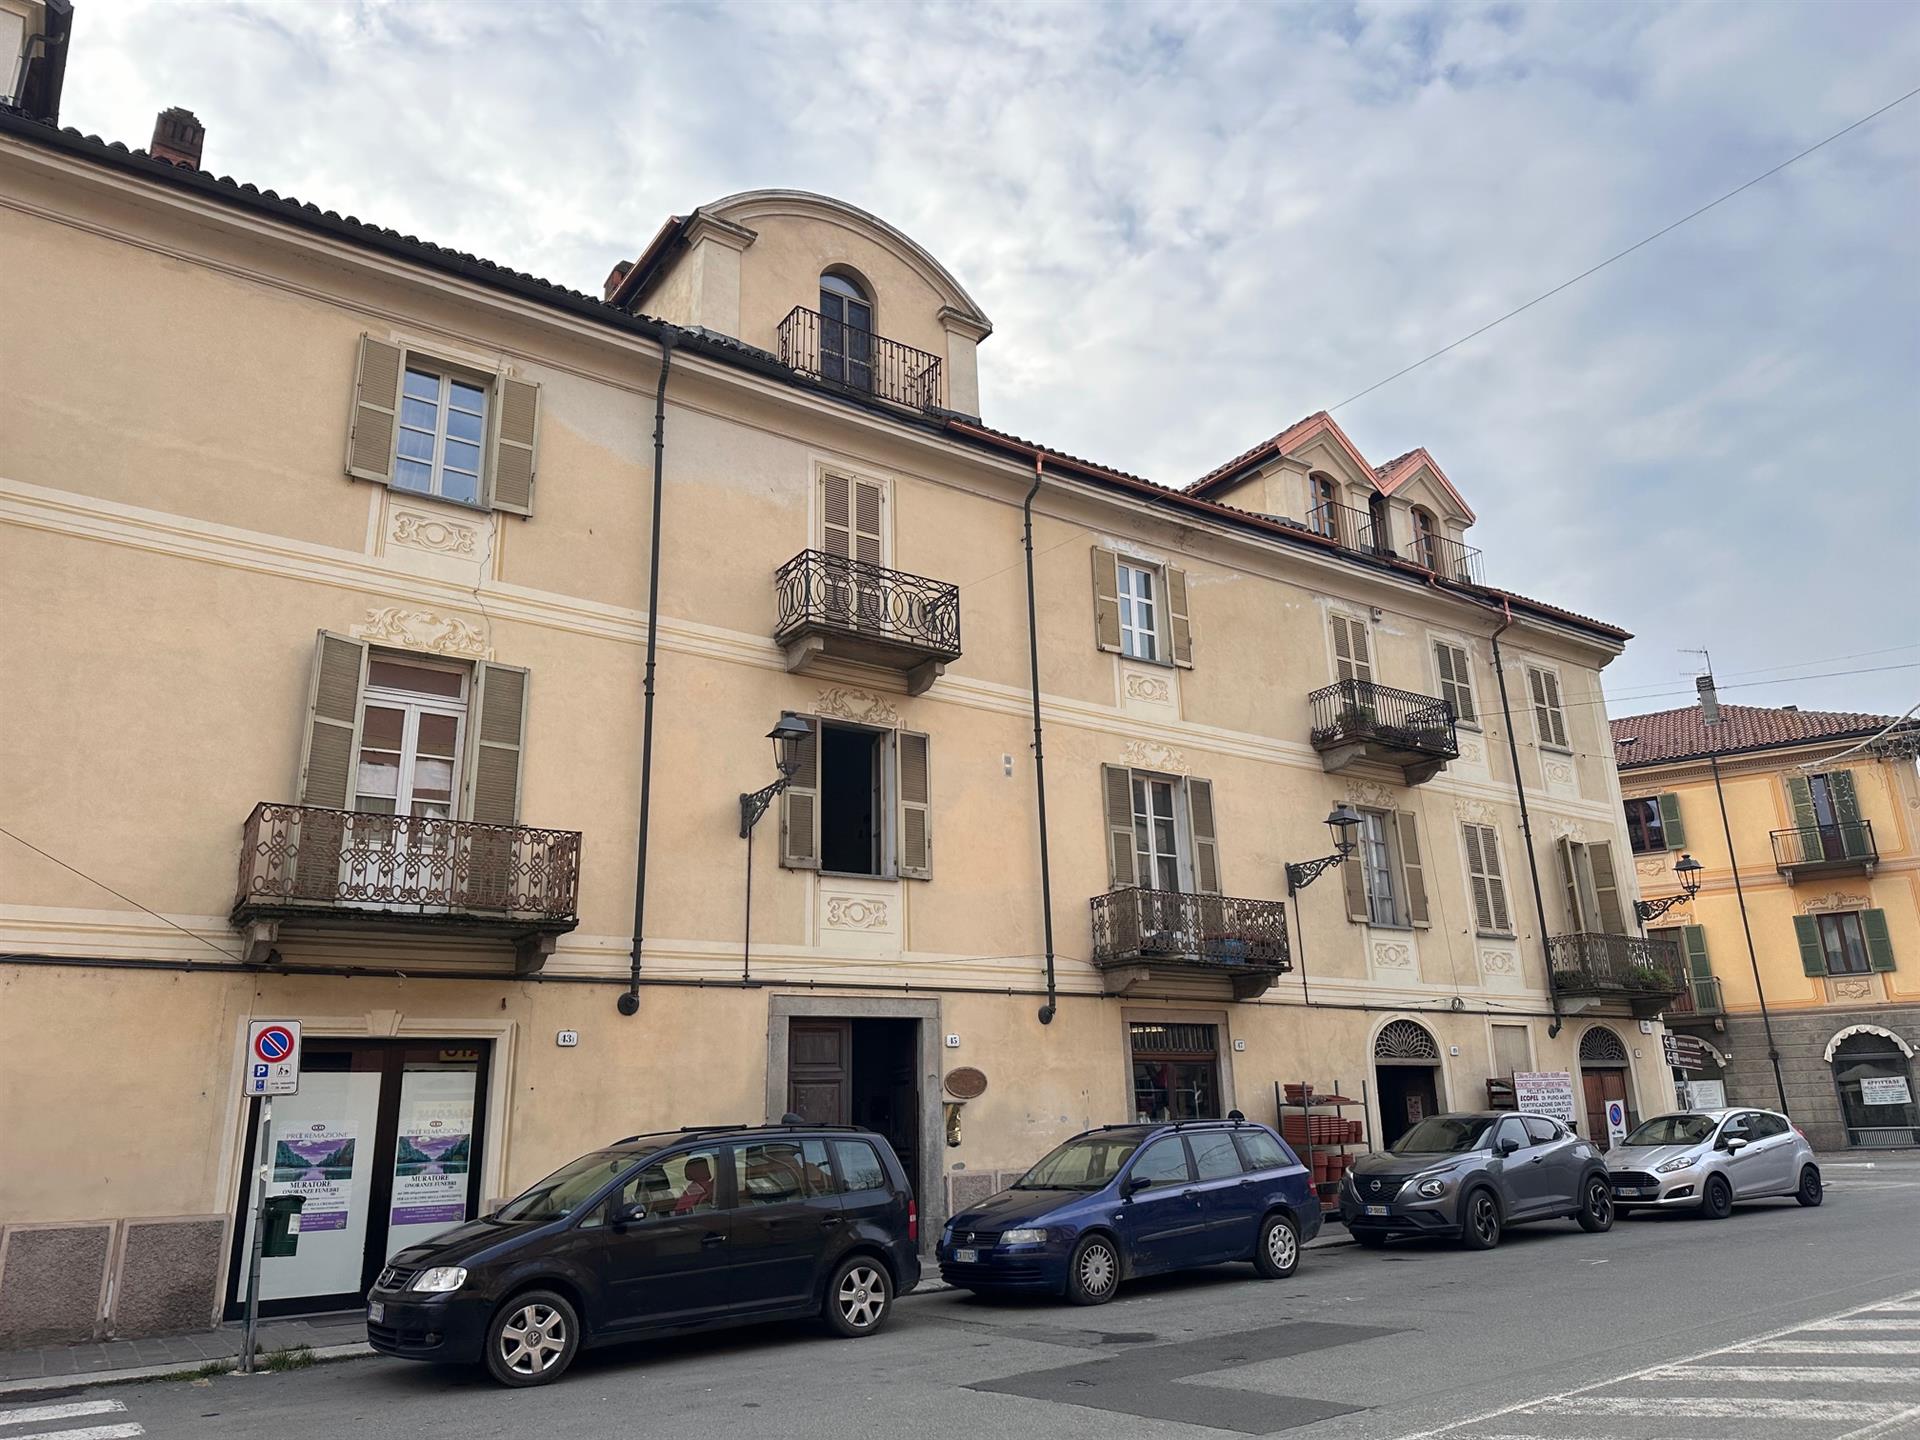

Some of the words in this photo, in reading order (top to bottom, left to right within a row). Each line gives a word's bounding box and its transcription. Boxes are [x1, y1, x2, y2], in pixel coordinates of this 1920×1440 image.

[256, 1066, 266, 1076] P
[411, 1174, 449, 1182] MURATORE
[290, 1181, 332, 1189] MURATORE
